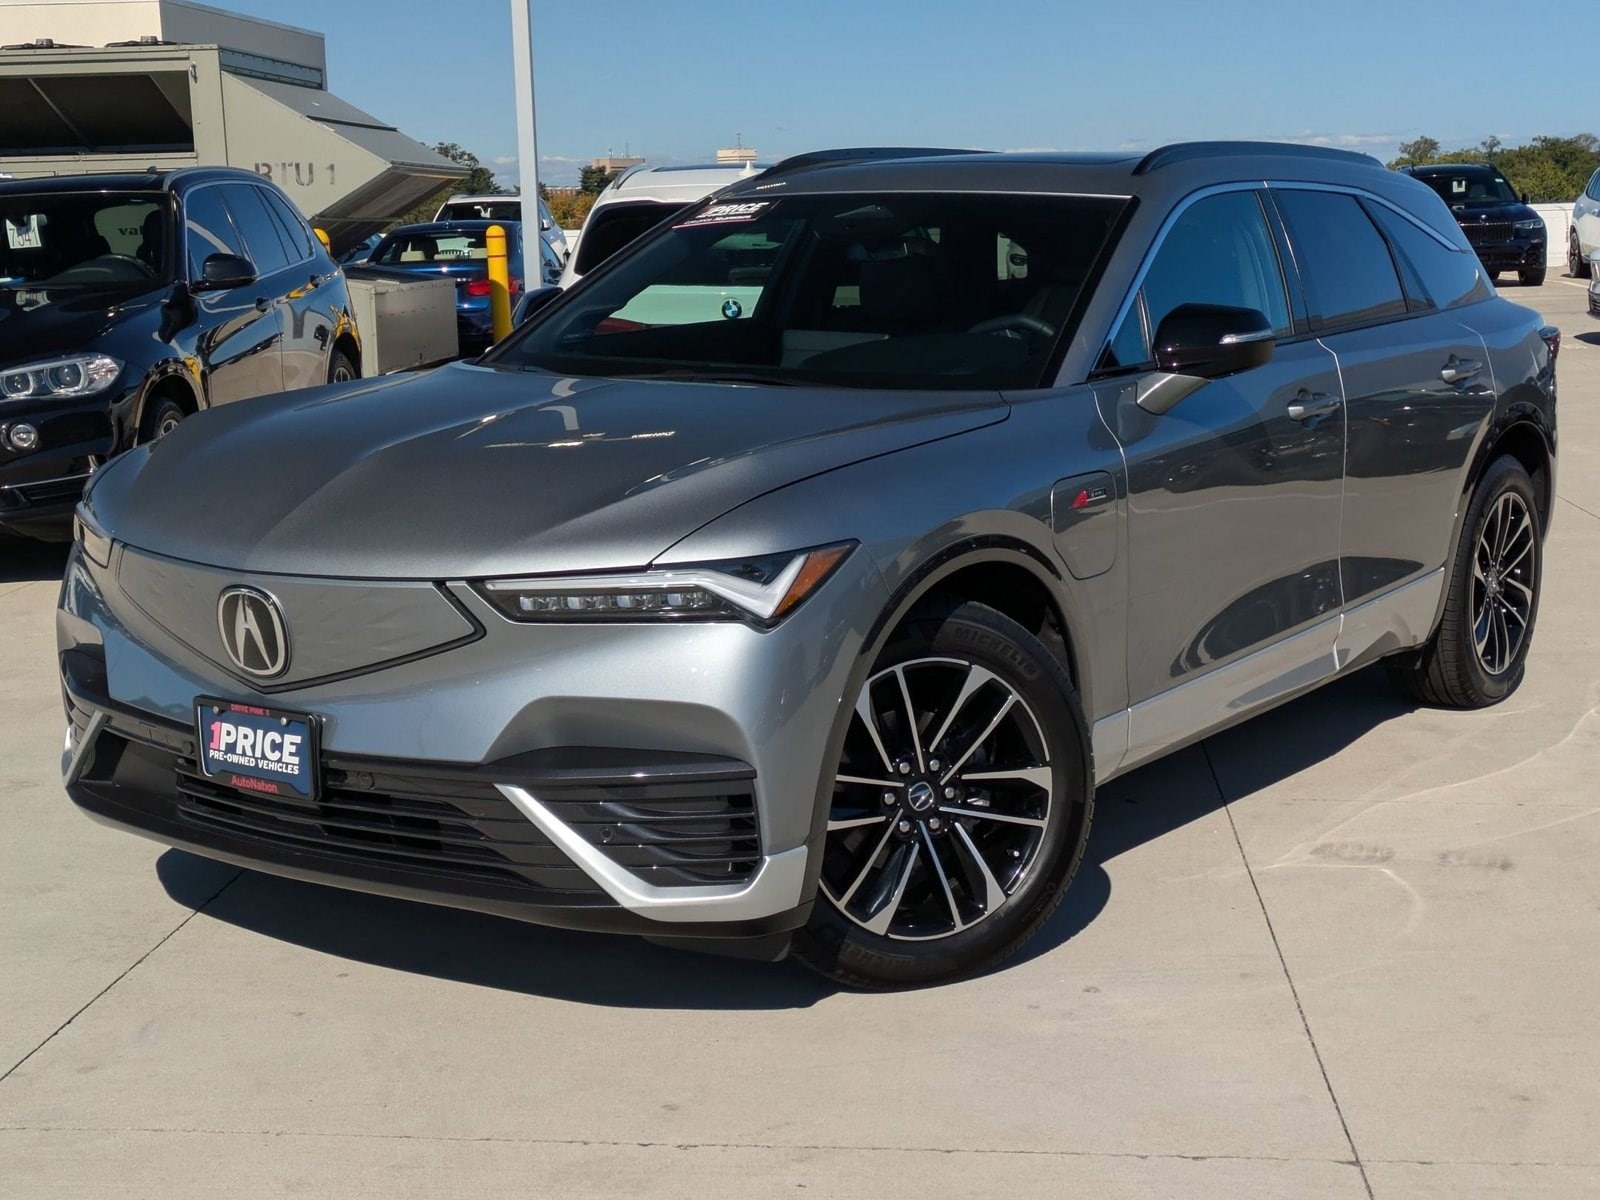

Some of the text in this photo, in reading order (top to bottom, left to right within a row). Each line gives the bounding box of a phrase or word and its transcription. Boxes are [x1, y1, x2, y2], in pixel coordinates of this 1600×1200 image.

[326, 163, 335, 185] 1
[209, 721, 302, 765] 1PRICE
[209, 749, 300, 775] PRE-OWNED VEHICLES
[231, 775, 280, 794] AutoNation
